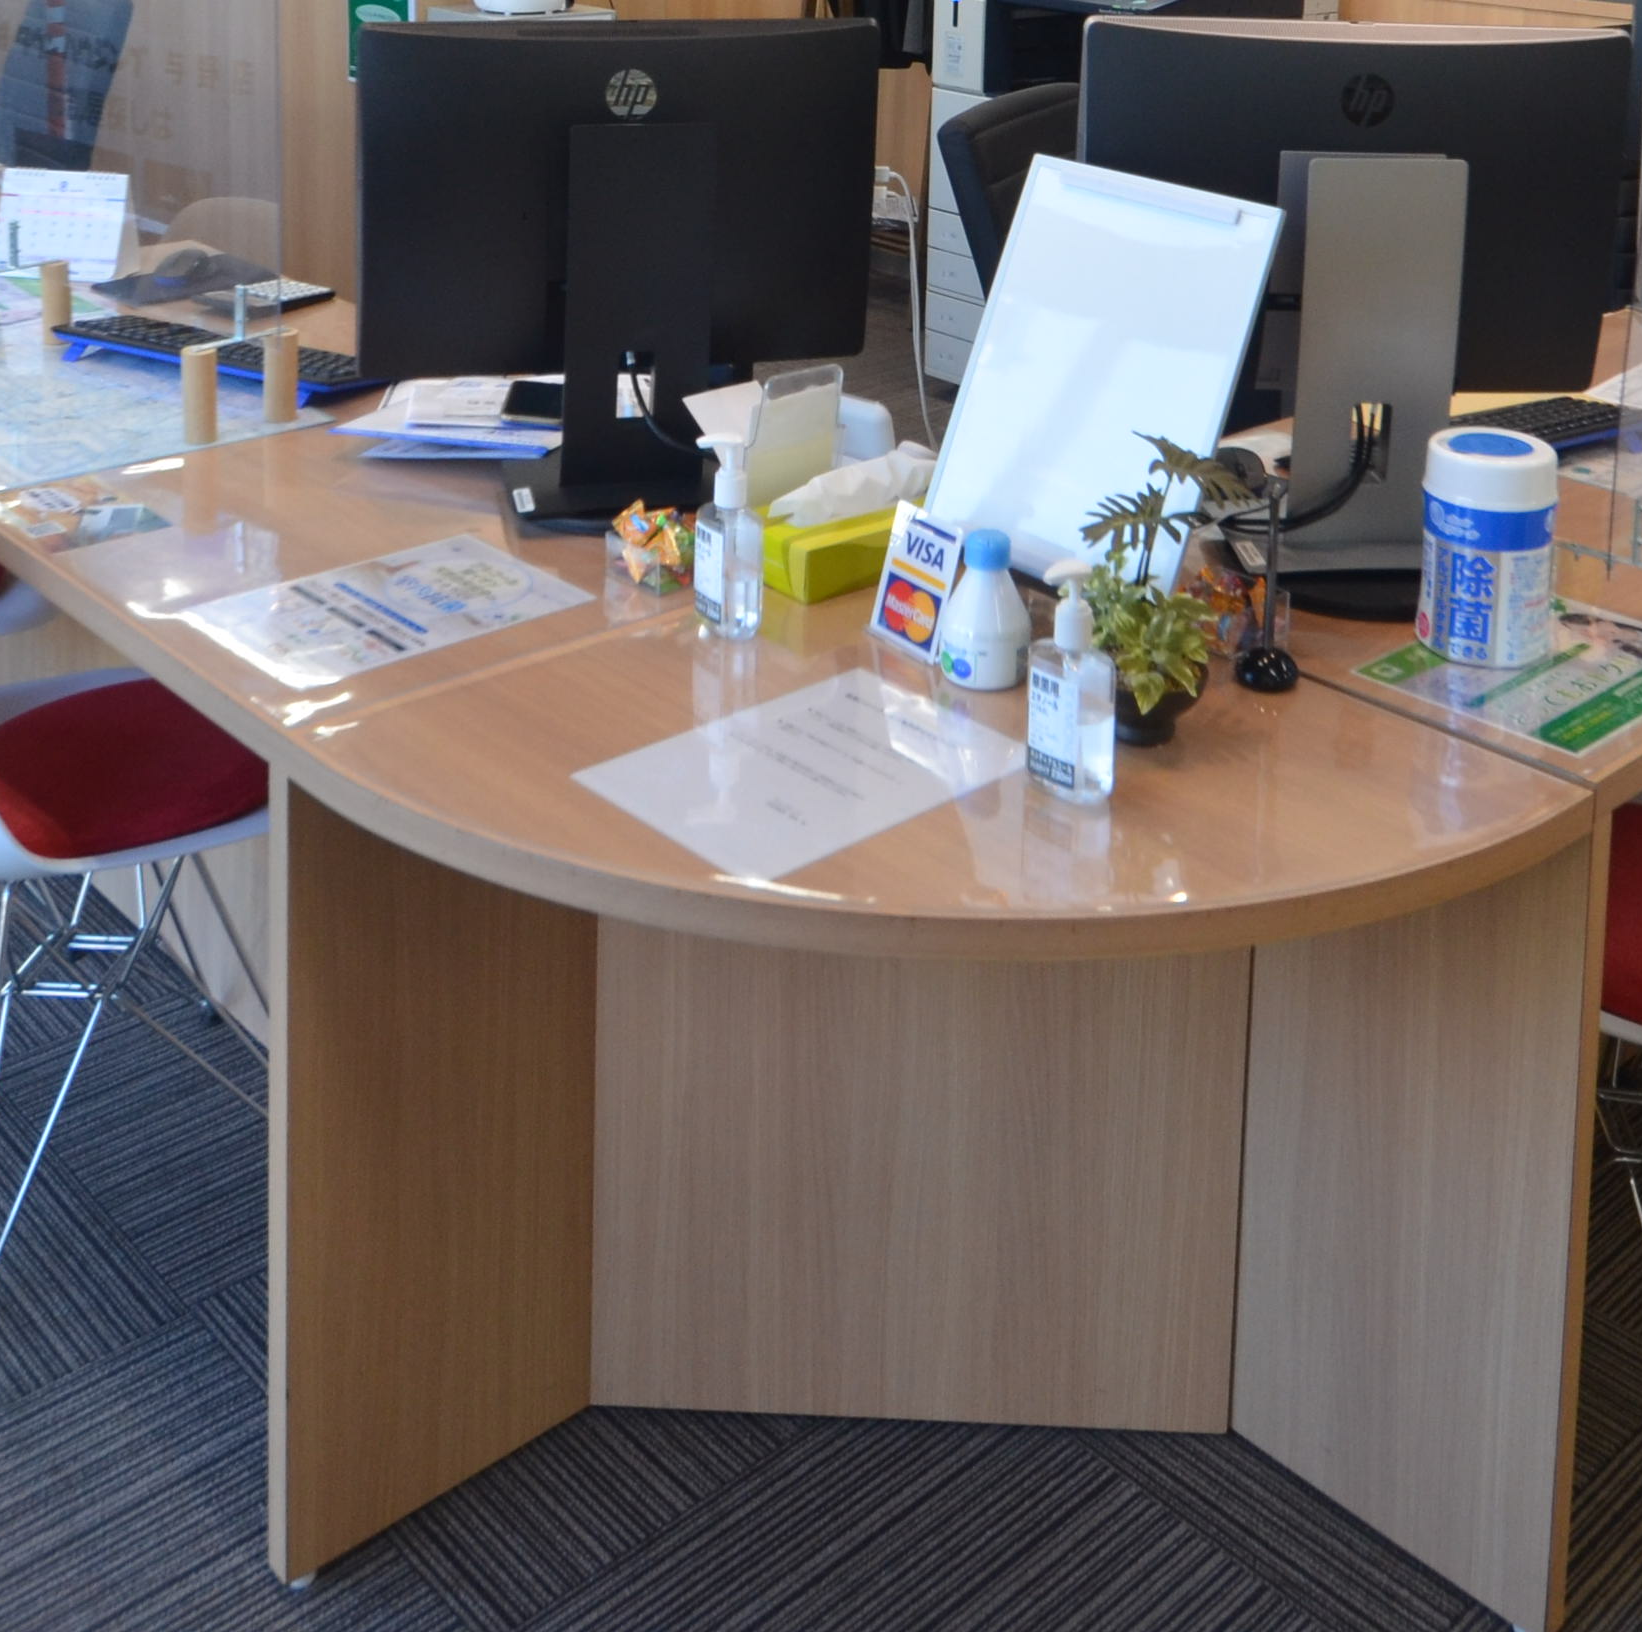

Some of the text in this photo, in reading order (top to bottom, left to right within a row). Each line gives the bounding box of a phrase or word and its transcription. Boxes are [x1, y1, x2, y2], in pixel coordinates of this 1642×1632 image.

[605, 68, 659, 119] hp
[1339, 72, 1396, 128] hp
[906, 530, 945, 573] VISA
[885, 592, 935, 630] MasterCard
[1449, 552, 1494, 644] 除菌
[1450, 642, 1488, 661] できる
